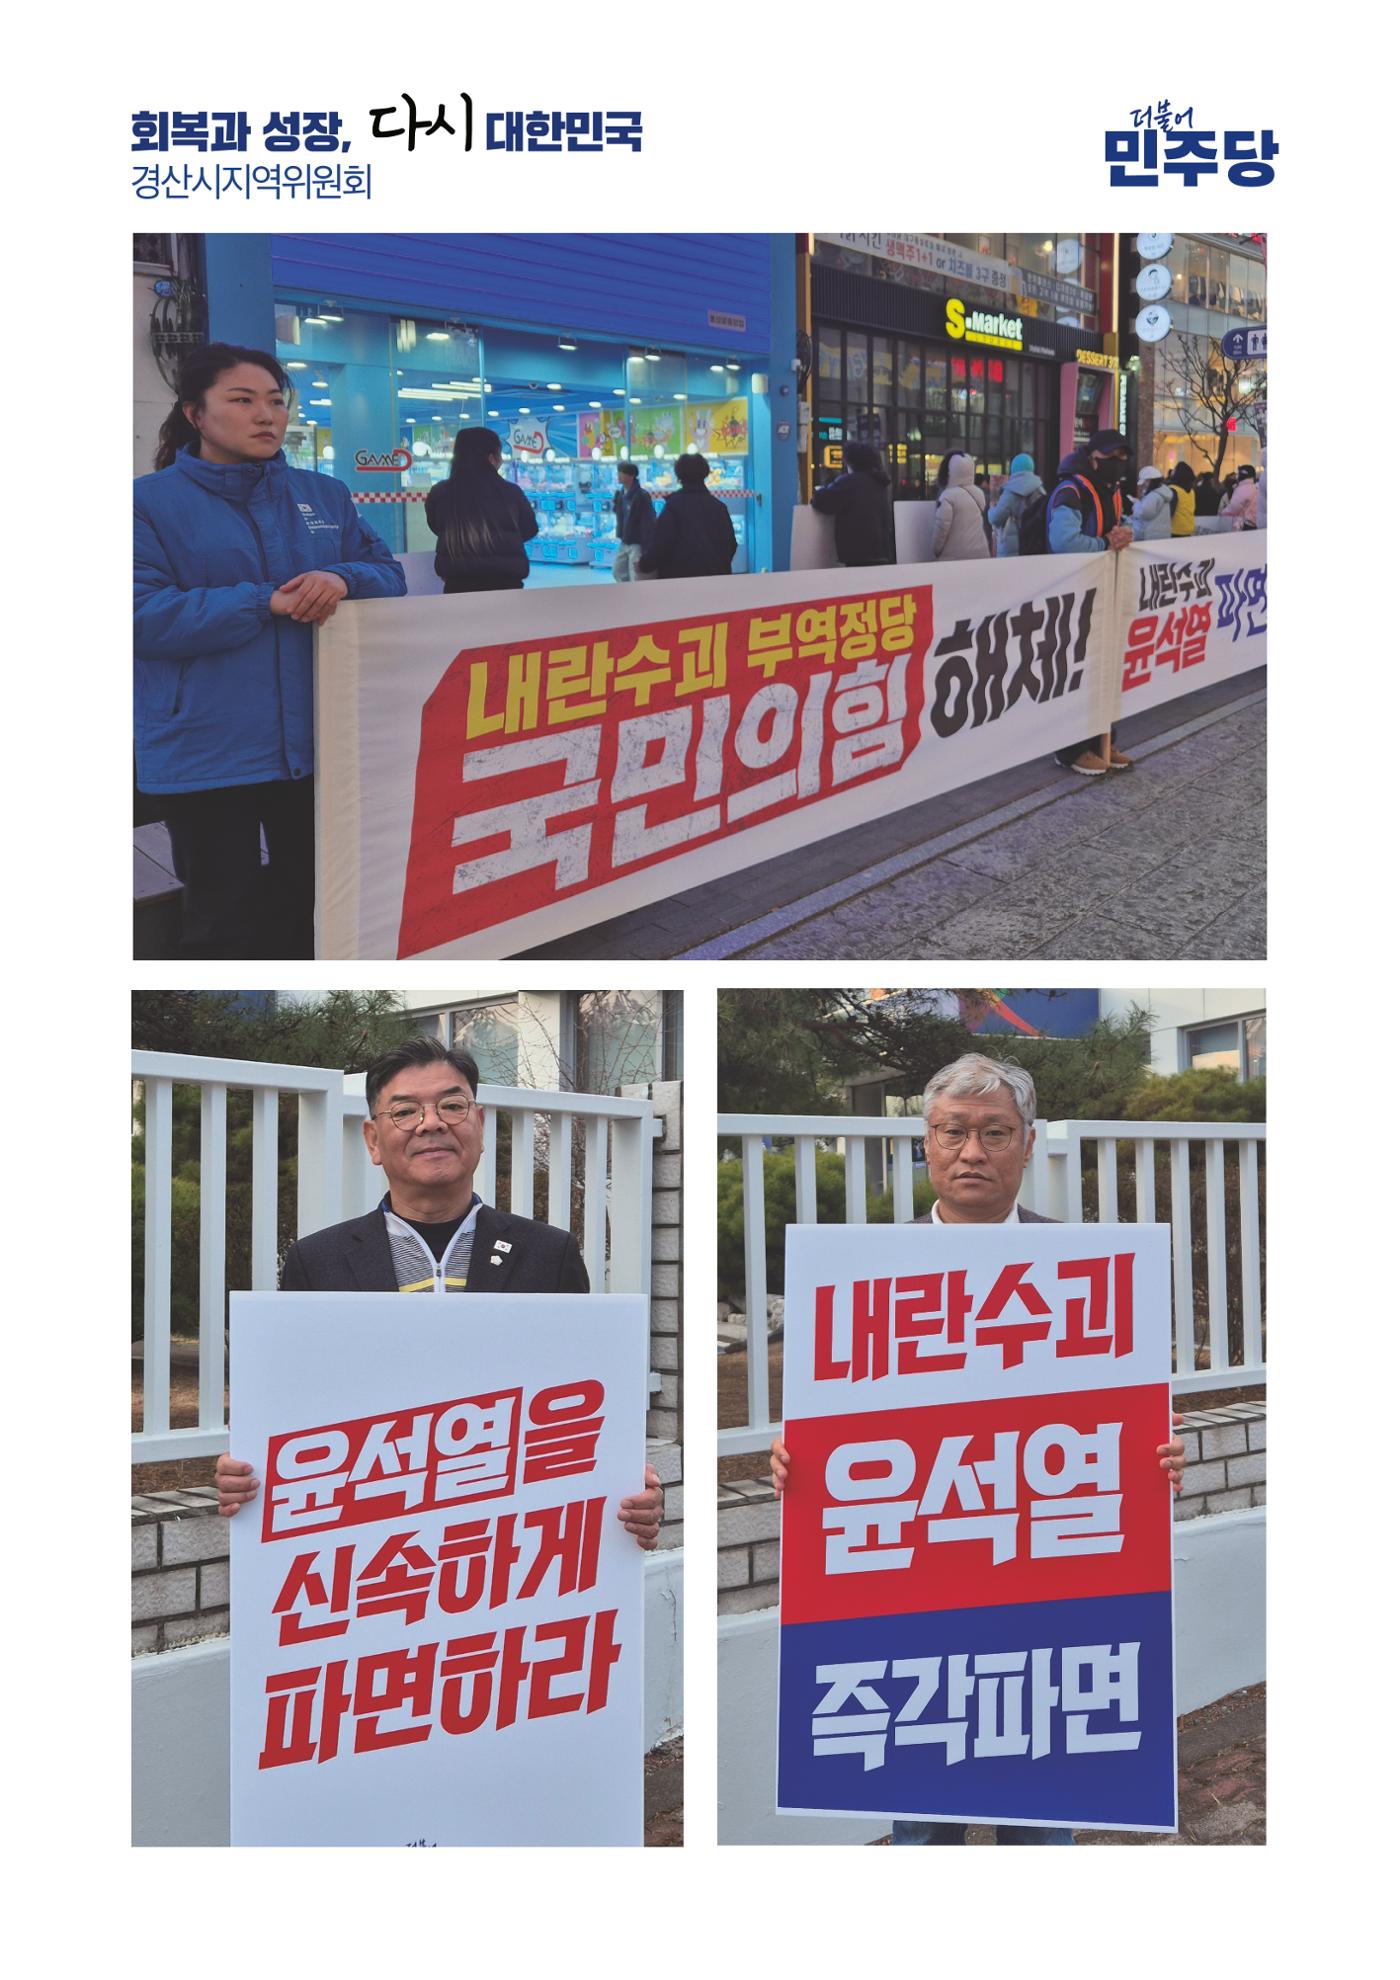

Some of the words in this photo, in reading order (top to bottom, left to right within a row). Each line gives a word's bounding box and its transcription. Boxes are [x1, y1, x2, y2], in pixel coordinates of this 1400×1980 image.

[936, 257, 946, 269] or
[466, 623, 728, 740] 내란수괴
[747, 594, 917, 678] 부역정당
[1121, 601, 1213, 692] 윤석열
[1139, 558, 1215, 611] 내란수괴
[1215, 563, 1267, 642] 파면
[451, 653, 911, 895] 국민의힘
[930, 587, 1097, 738] 해체!
[814, 1252, 1136, 1383] 내란수괴
[272, 1379, 605, 1534] 윤석열을
[821, 1421, 1124, 1575] 윤석열
[272, 1496, 607, 1647] 신속하게
[258, 1608, 622, 1770] 파면하라
[812, 1641, 1142, 1772] 즉각파면
